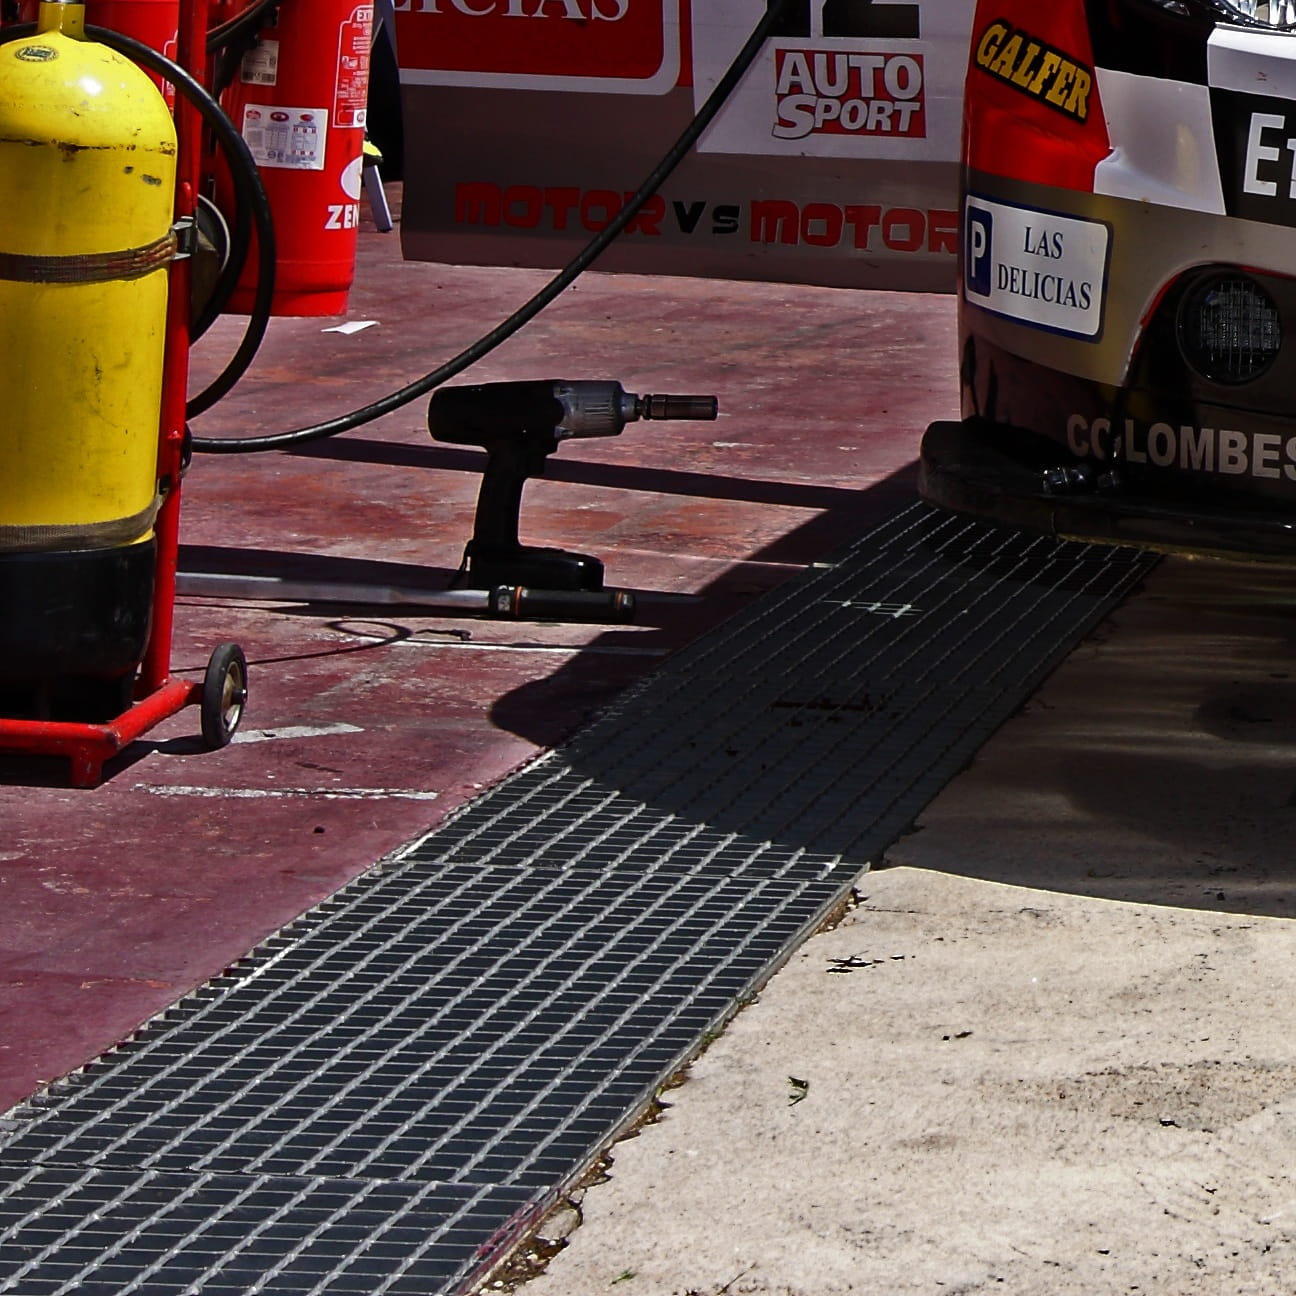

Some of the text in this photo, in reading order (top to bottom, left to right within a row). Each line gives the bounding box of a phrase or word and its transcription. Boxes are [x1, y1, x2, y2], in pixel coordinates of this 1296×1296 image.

[777, 50, 923, 102] AUTO
[976, 22, 1092, 119] GALFER
[771, 92, 921, 140] SPORT
[971, 220, 1064, 278] P LAS
[997, 263, 1092, 311] DELICIAS
